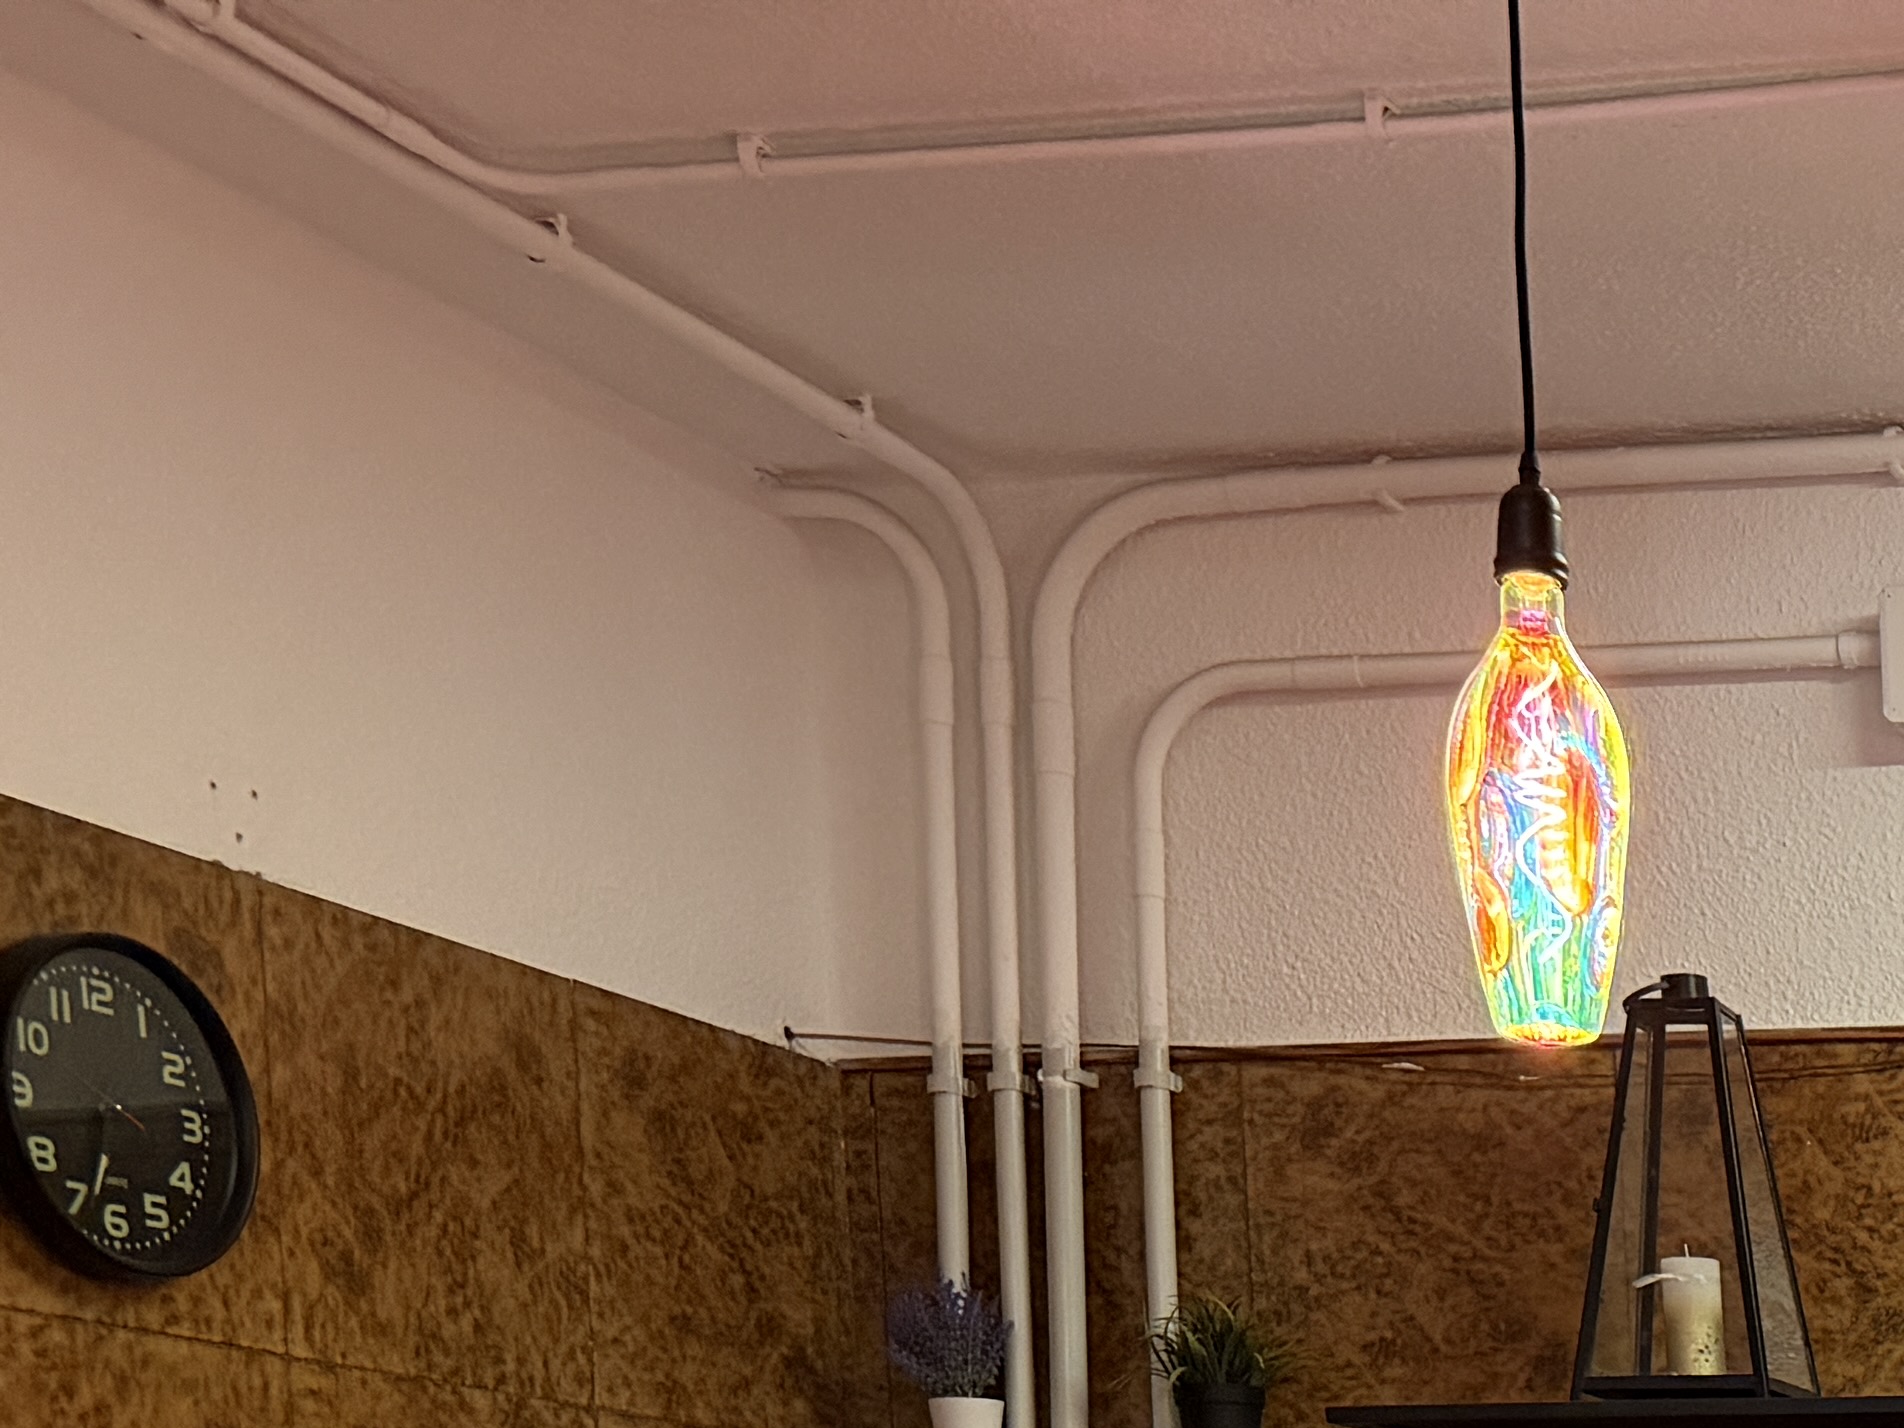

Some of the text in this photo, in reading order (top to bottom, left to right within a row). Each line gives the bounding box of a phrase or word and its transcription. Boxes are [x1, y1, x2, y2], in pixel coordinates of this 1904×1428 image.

[50, 985, 71, 1023] 11
[80, 975, 114, 1016] 12
[16, 1016, 49, 1056] 10
[137, 1003, 147, 1038] 1
[161, 1051, 186, 1087] 2
[12, 1070, 33, 1108] 9
[180, 1108, 203, 1144] 3
[26, 1135, 57, 1172] 8
[169, 1161, 194, 1195] 4
[65, 1179, 88, 1215] 7
[143, 1192, 170, 1229] 5
[103, 1203, 130, 1239] 6
